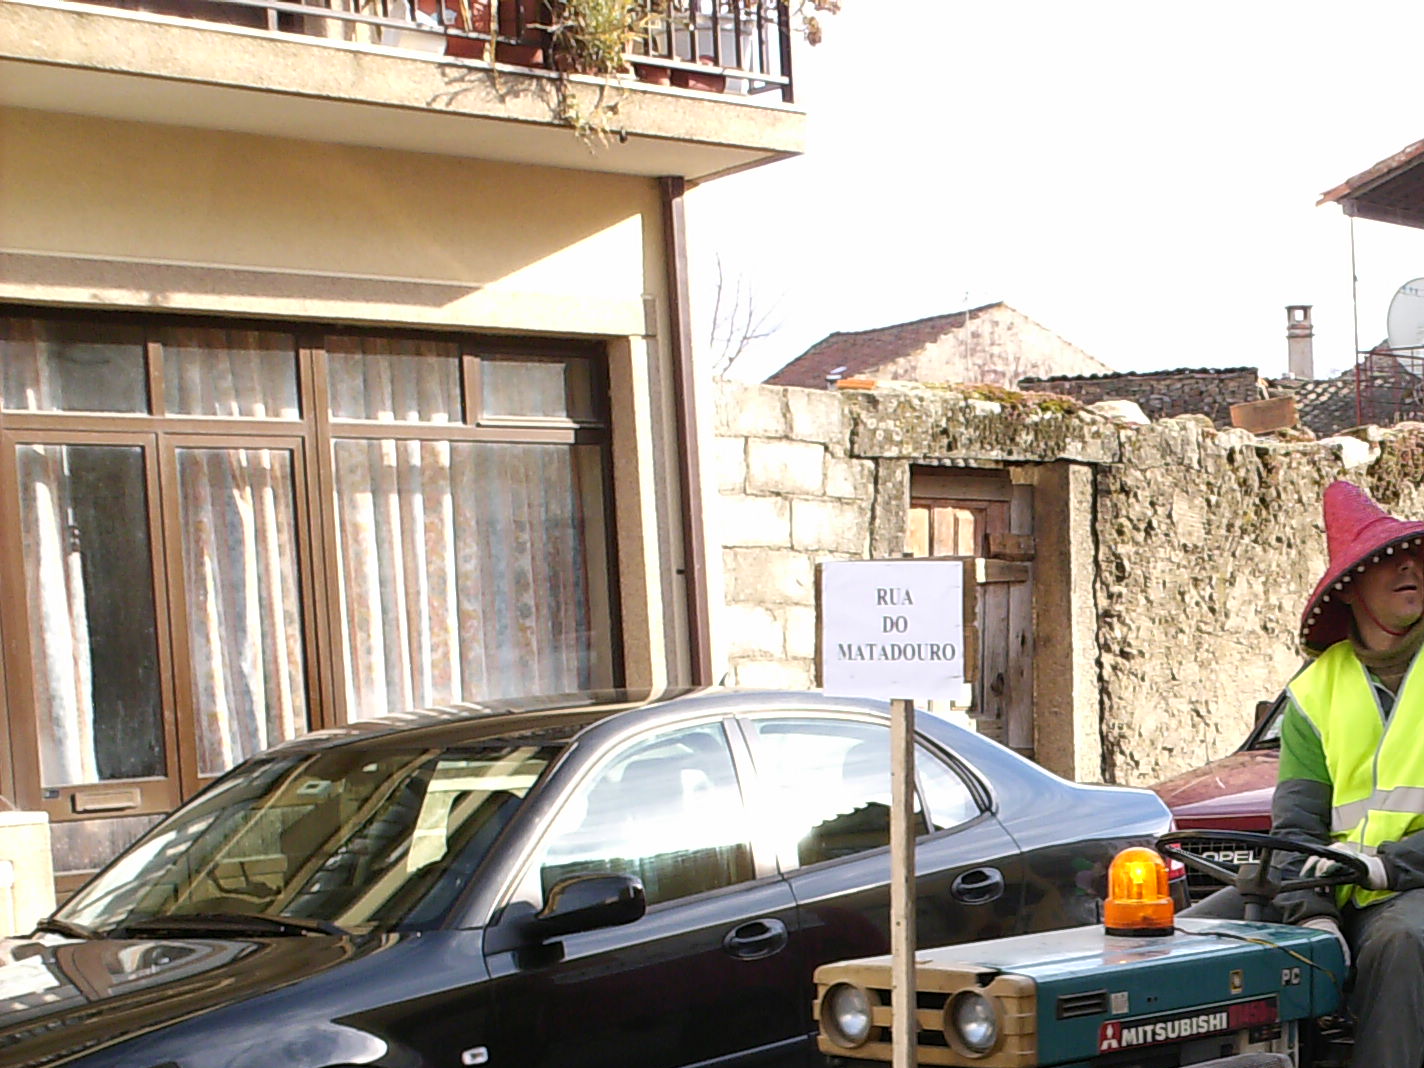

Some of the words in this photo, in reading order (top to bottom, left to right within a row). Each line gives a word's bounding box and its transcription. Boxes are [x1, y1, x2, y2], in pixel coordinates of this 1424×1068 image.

[877, 588, 914, 605] RUA
[883, 616, 908, 633] DO
[838, 643, 956, 661] MATADOURO
[1121, 1011, 1228, 1047] MITSUBISHI
